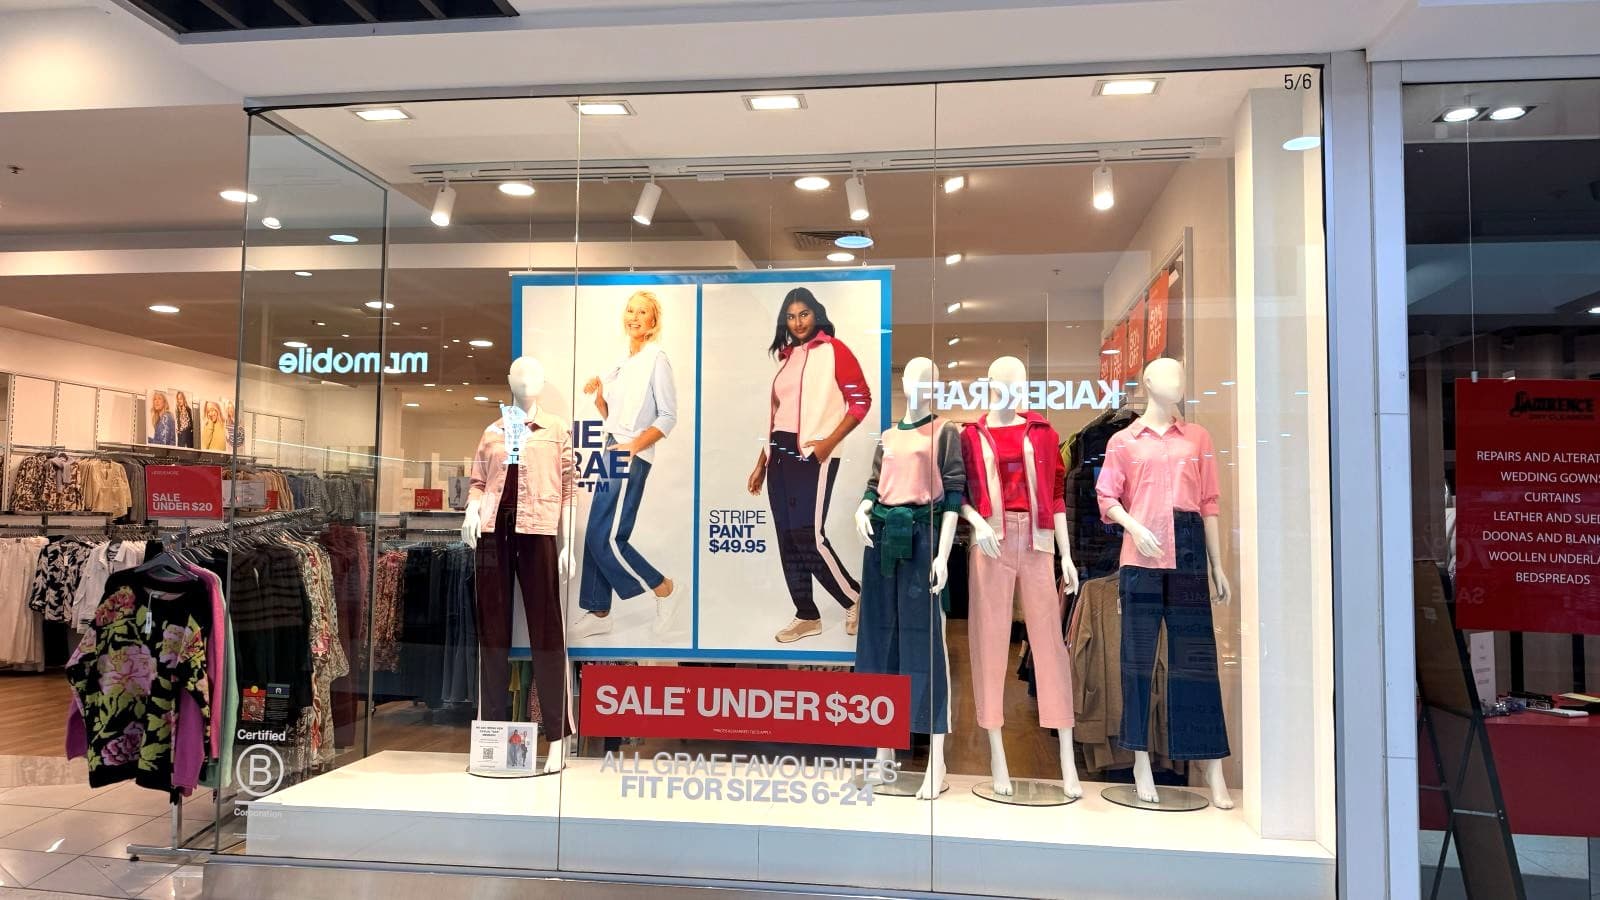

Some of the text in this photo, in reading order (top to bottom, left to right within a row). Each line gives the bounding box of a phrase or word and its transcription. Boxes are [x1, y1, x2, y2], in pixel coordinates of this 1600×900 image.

[1284, 73, 1312, 90] 5/6
[1476, 450, 1522, 462] REPAIRS
[1524, 452, 1551, 463] AND
[1500, 471, 1558, 483] WEDDING
[152, 493, 181, 502] SALE
[1524, 491, 1581, 504] CURTAINS
[152, 502, 213, 512] UNDER $20
[708, 509, 767, 525] STRIPE
[1493, 510, 1543, 523] LEATHER
[1545, 512, 1572, 524] AND
[708, 524, 755, 539] PANT
[1482, 530, 1534, 542] DOONAS
[1536, 532, 1563, 543] AND
[708, 538, 767, 555] $49.95
[1488, 551, 1547, 563] WOOLLEN
[1515, 572, 1591, 585] BEDSPREADS
[697, 687, 820, 722] UNDER
[825, 690, 895, 727] $30
[237, 729, 286, 742] Certified
[248, 754, 273, 786] B
[600, 750, 649, 775] ALL
[652, 751, 727, 777] GRAE
[621, 775, 876, 807] FIT FOR SIZES 6-24
